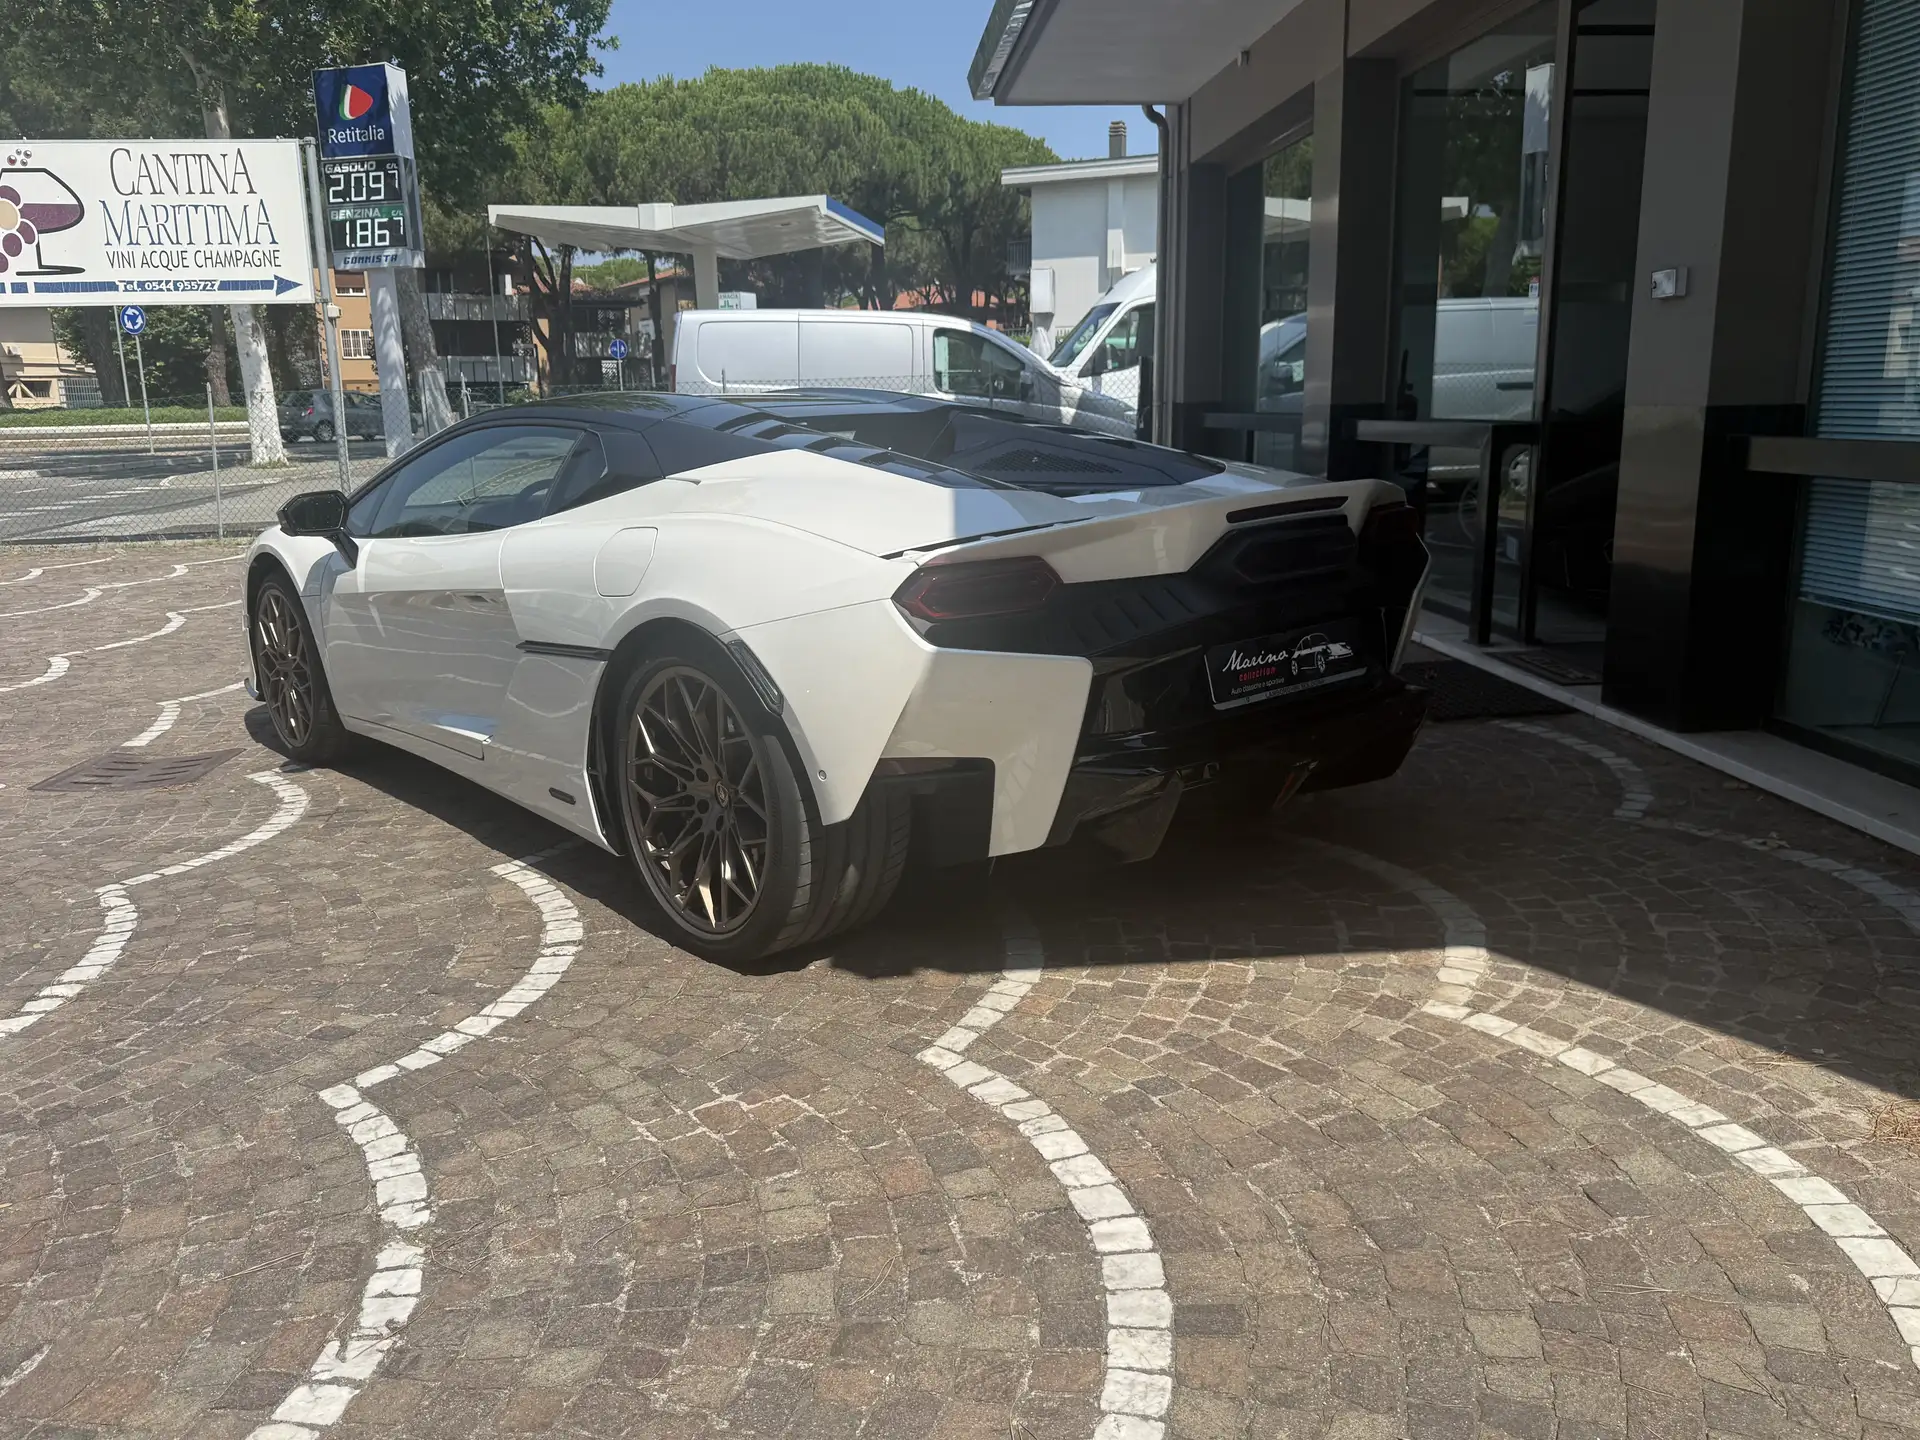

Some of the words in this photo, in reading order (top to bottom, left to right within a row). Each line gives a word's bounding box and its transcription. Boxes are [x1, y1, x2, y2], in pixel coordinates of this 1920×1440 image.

[328, 124, 385, 144] Retitalia
[109, 147, 258, 196] CANTINA
[325, 161, 376, 174] GASOLIO
[98, 198, 280, 246] MARITTIMA
[330, 207, 381, 220] BENZINA
[105, 250, 136, 269] VINI
[140, 250, 190, 271] ACQUE
[194, 249, 282, 268] CHAMPAGNE
[343, 254, 398, 265] GOMMISTA
[119, 280, 141, 291] Tel.
[145, 280, 173, 291] 0544
[176, 280, 219, 291] 955727
[1222, 649, 1289, 672] Marino
